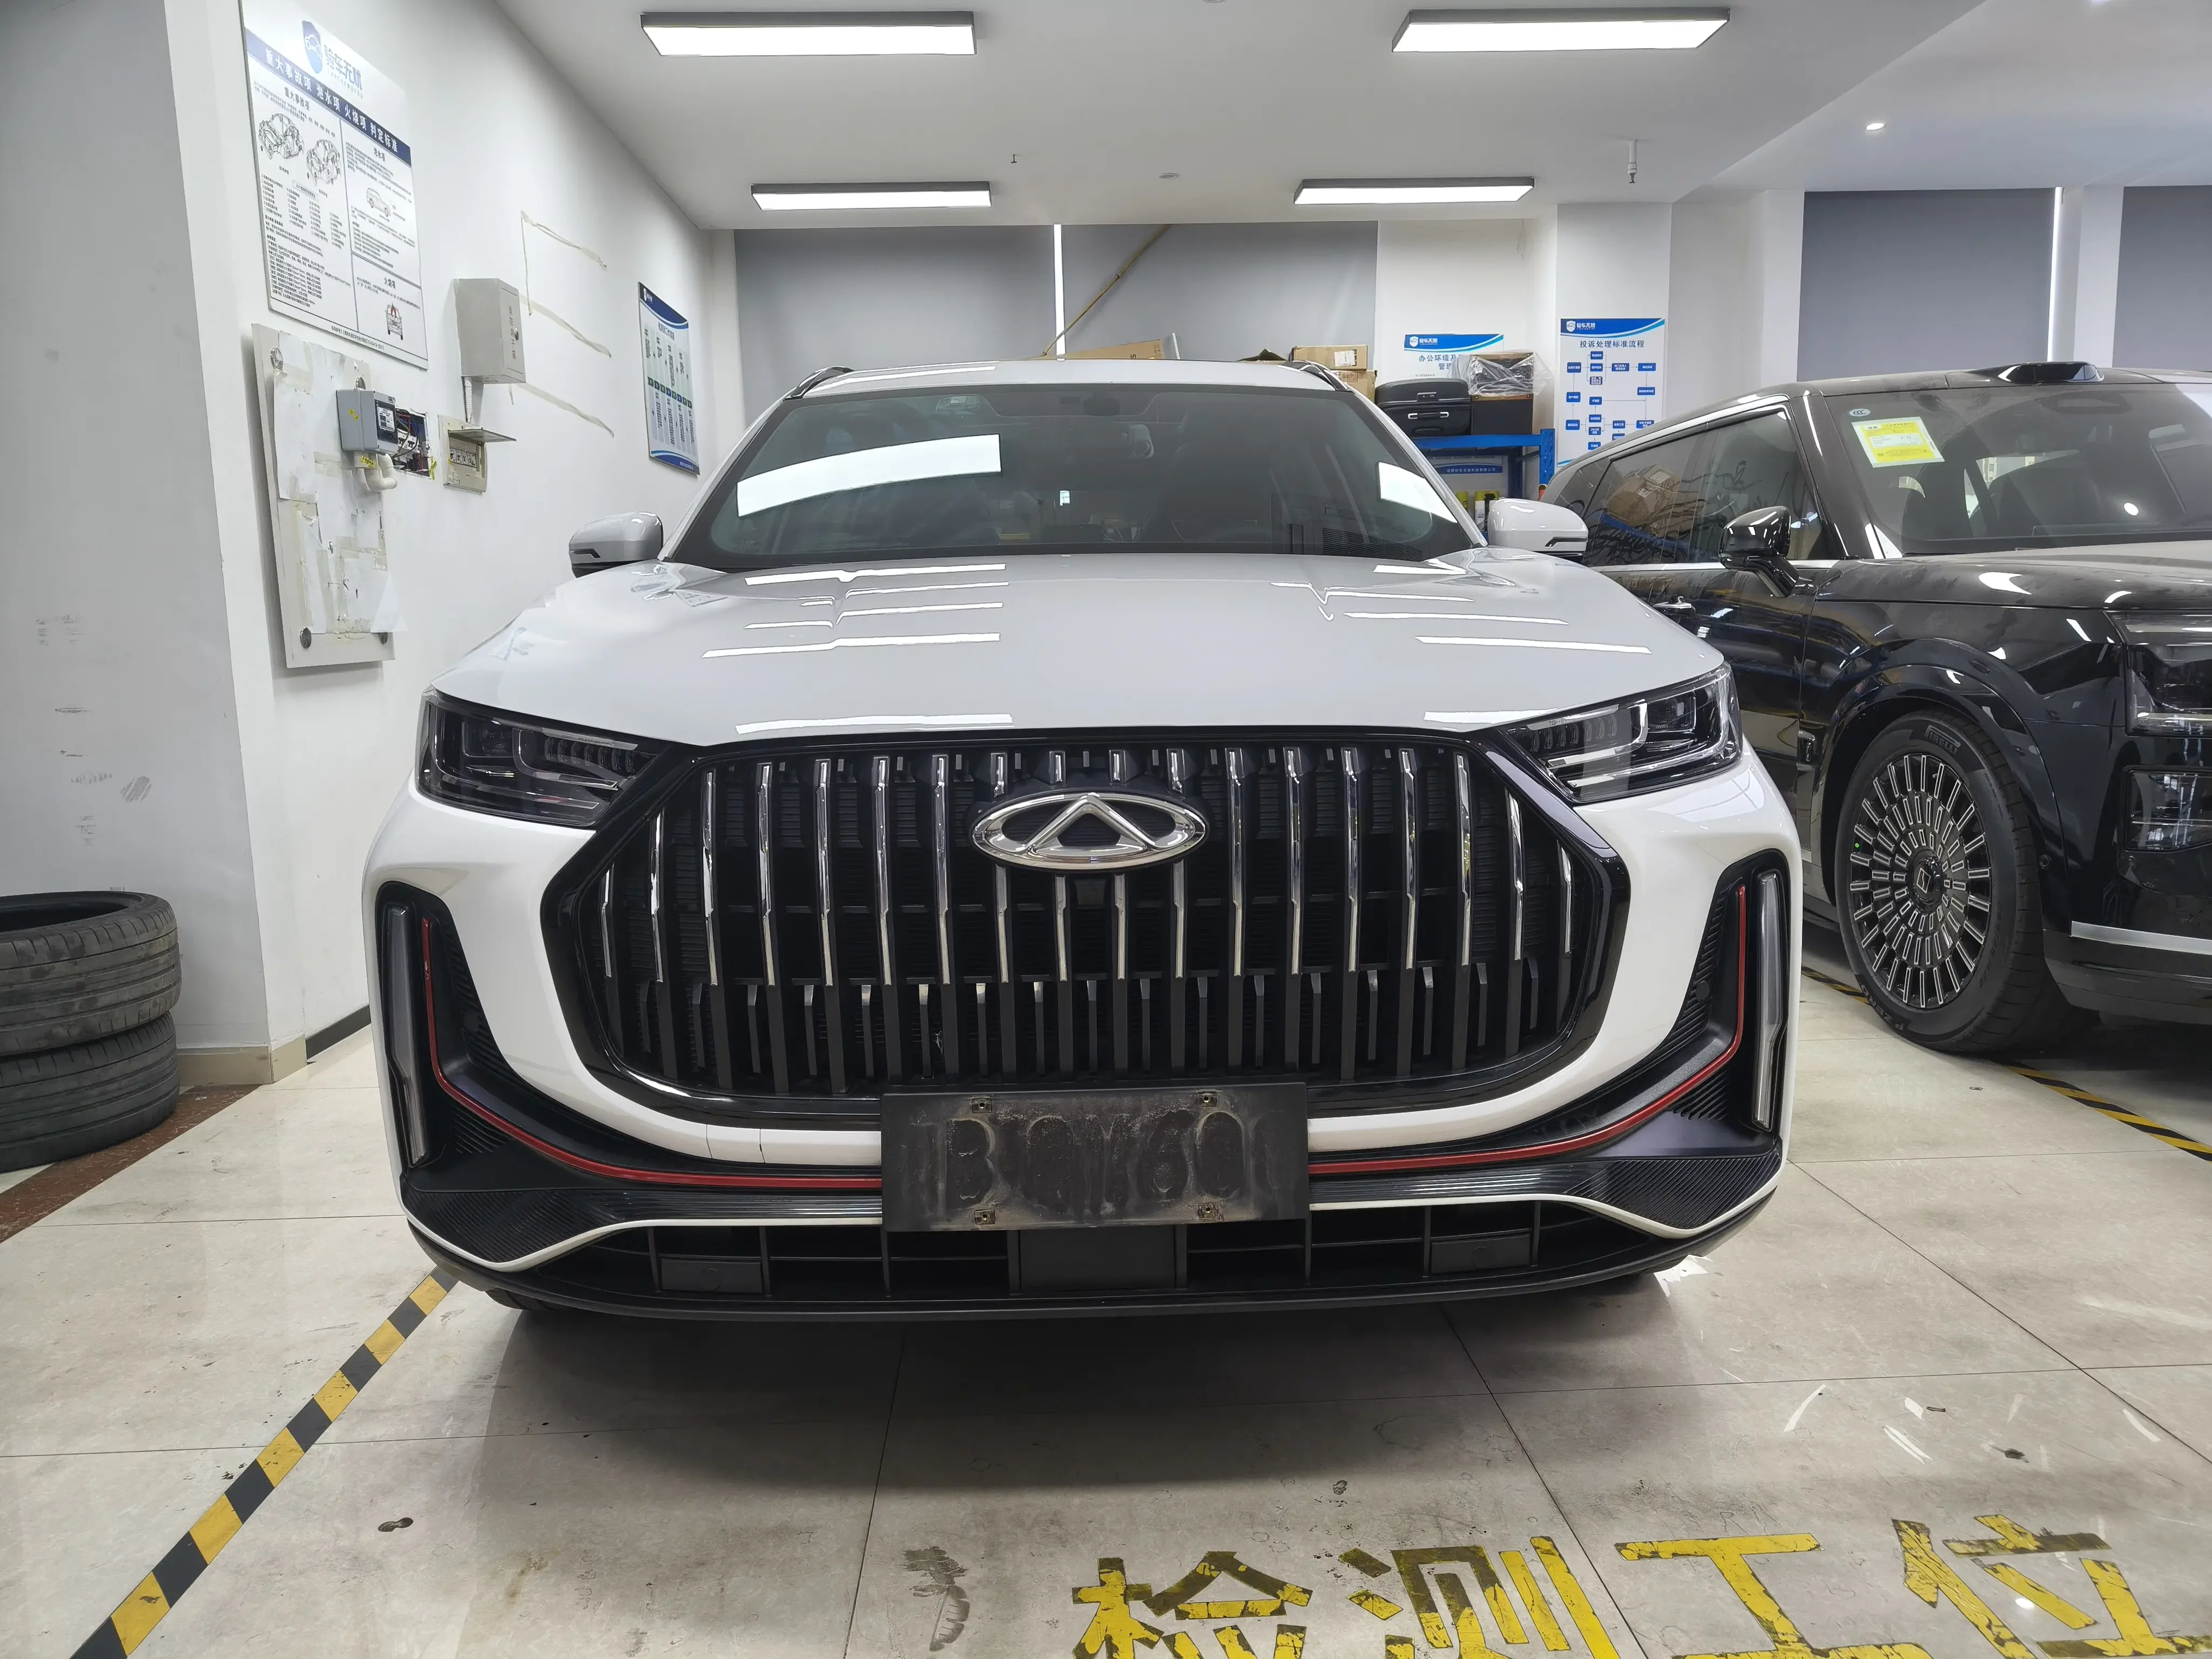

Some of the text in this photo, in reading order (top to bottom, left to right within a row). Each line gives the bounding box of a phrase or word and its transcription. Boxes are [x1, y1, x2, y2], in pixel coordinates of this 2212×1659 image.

[265, 49, 312, 92] 重大事故项
[316, 82, 340, 112] 泡水项
[345, 104, 367, 131] 火烧项
[370, 124, 398, 153] 判定标准
[1925, 724, 1961, 756] PIRELLI
[1860, 984, 1893, 1023] ZERO
[1072, 1514, 2212, 1659] 检测工位
